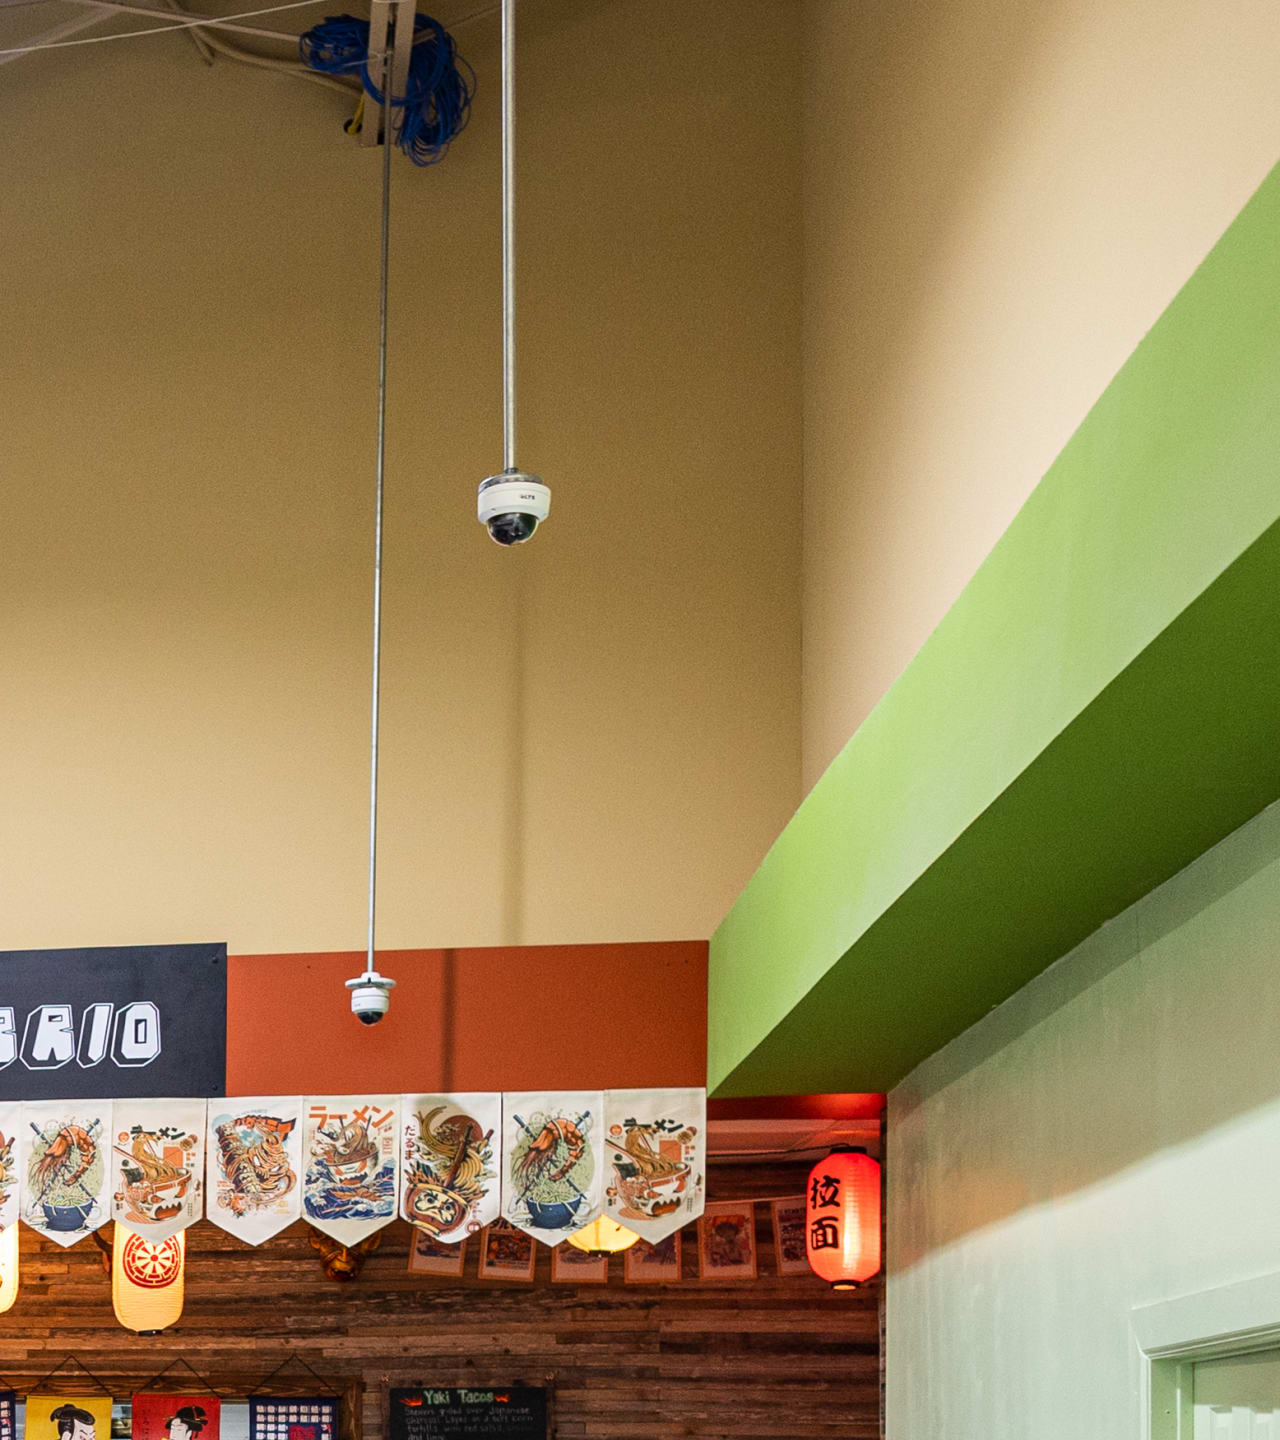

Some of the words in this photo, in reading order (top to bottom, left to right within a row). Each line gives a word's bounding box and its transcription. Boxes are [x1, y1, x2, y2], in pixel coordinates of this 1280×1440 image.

[424, 1390, 450, 1405] Yaki
[457, 1389, 494, 1403] Tacos
[489, 1407, 530, 1416] Japanese
